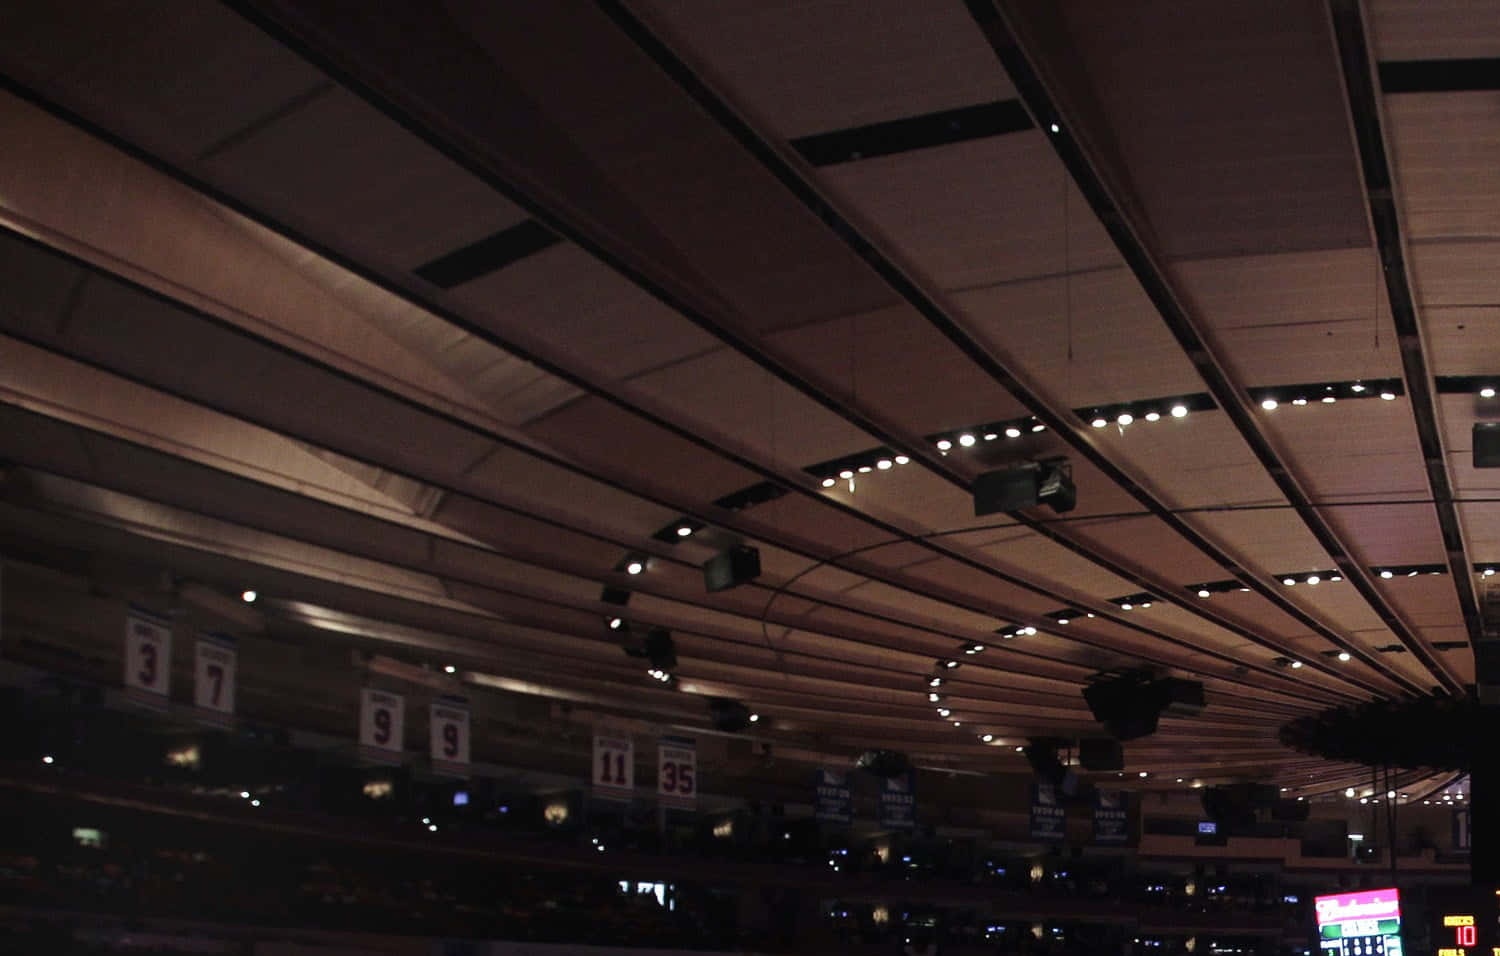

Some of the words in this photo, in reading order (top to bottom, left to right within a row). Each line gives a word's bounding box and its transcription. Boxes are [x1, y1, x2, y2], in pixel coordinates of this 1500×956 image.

[140, 643, 157, 685] 3
[207, 663, 223, 705] 7
[374, 708, 392, 744] 9
[444, 723, 459, 758] 9
[601, 752, 625, 785] 11
[662, 761, 693, 794] 35
[1457, 926, 1475, 946] 10
